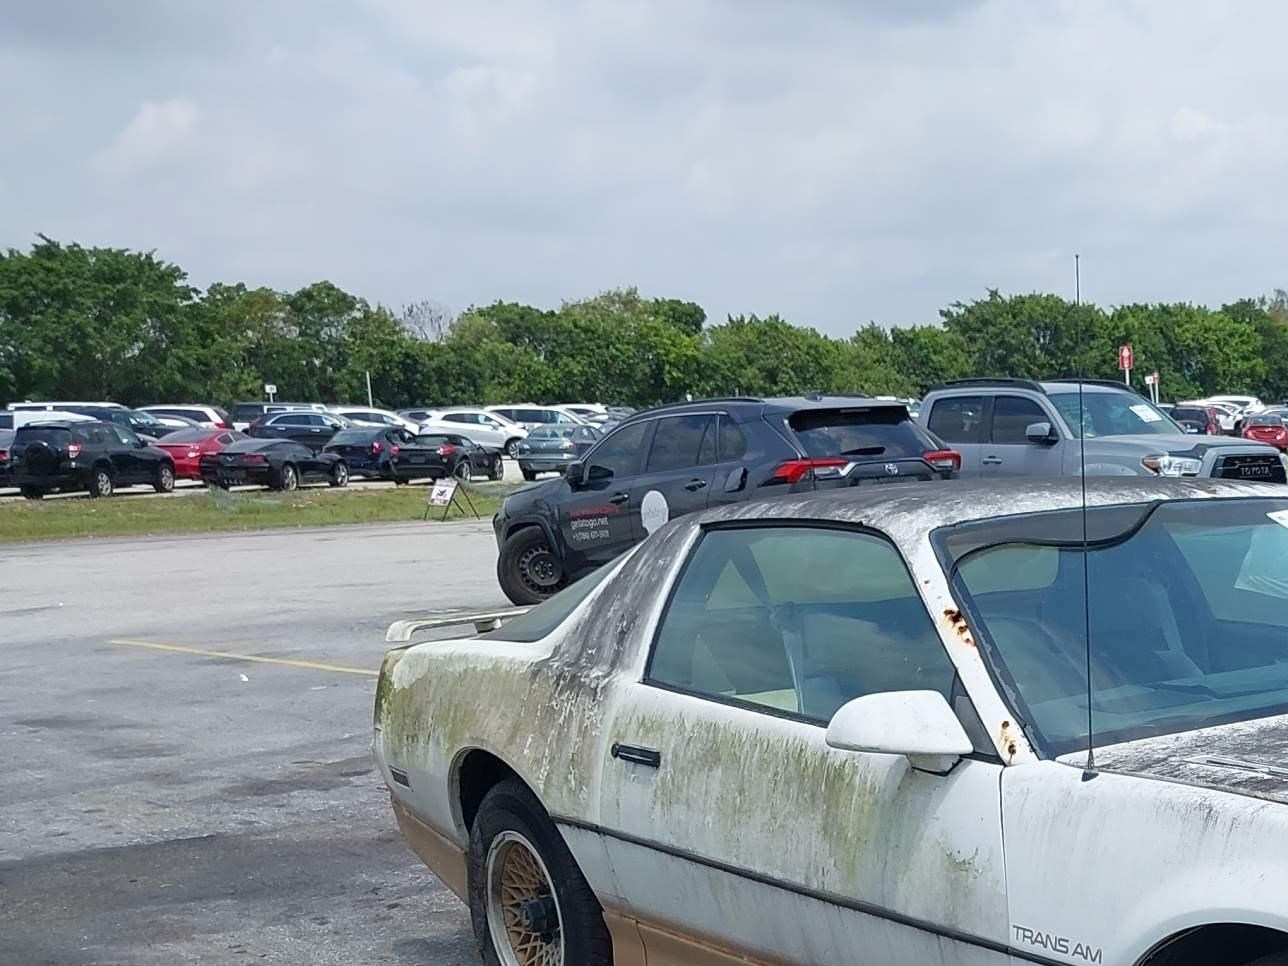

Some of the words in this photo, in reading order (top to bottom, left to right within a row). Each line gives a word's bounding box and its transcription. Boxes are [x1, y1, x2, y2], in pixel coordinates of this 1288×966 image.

[1240, 466, 1270, 476] TOYOTA
[1012, 924, 1069, 955] TRANS
[1071, 942, 1103, 965] AM
